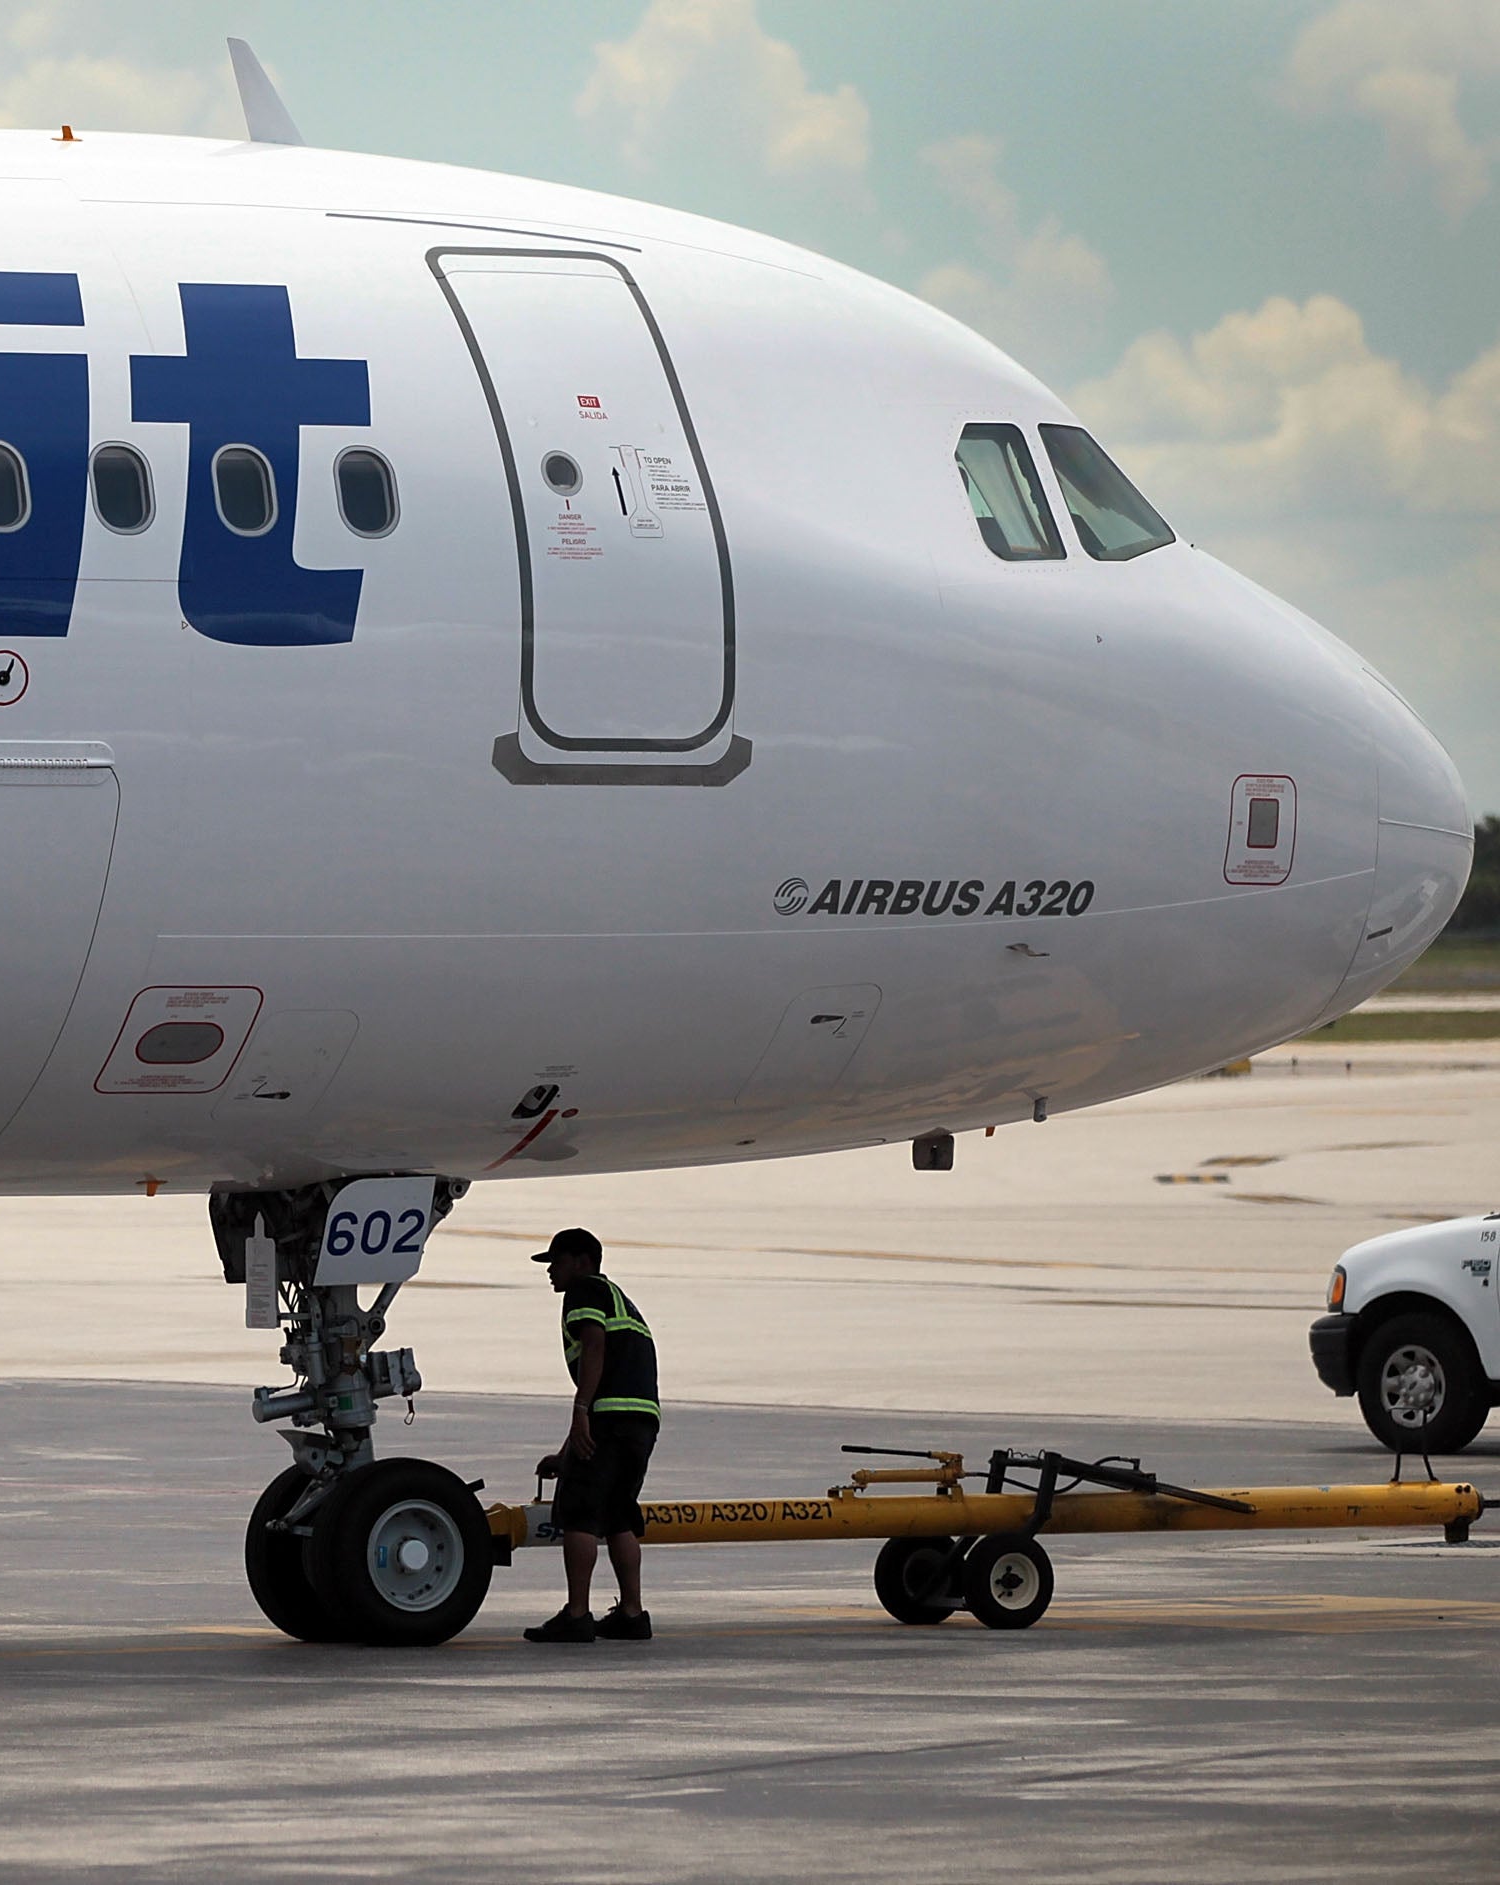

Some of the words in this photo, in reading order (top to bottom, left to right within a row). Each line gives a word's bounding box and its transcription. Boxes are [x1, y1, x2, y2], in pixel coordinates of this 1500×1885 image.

[580, 397, 598, 407] EXIT
[579, 410, 608, 420] SALIDA
[643, 456, 653, 464] TO
[654, 457, 672, 465] OPEN
[651, 484, 670, 492] PARA
[806, 879, 985, 917] AIRBUS
[983, 880, 1095, 917] A320
[327, 1208, 425, 1256] 602
[1480, 1231, 1497, 1242] 158
[782, 1501, 833, 1521] A321
